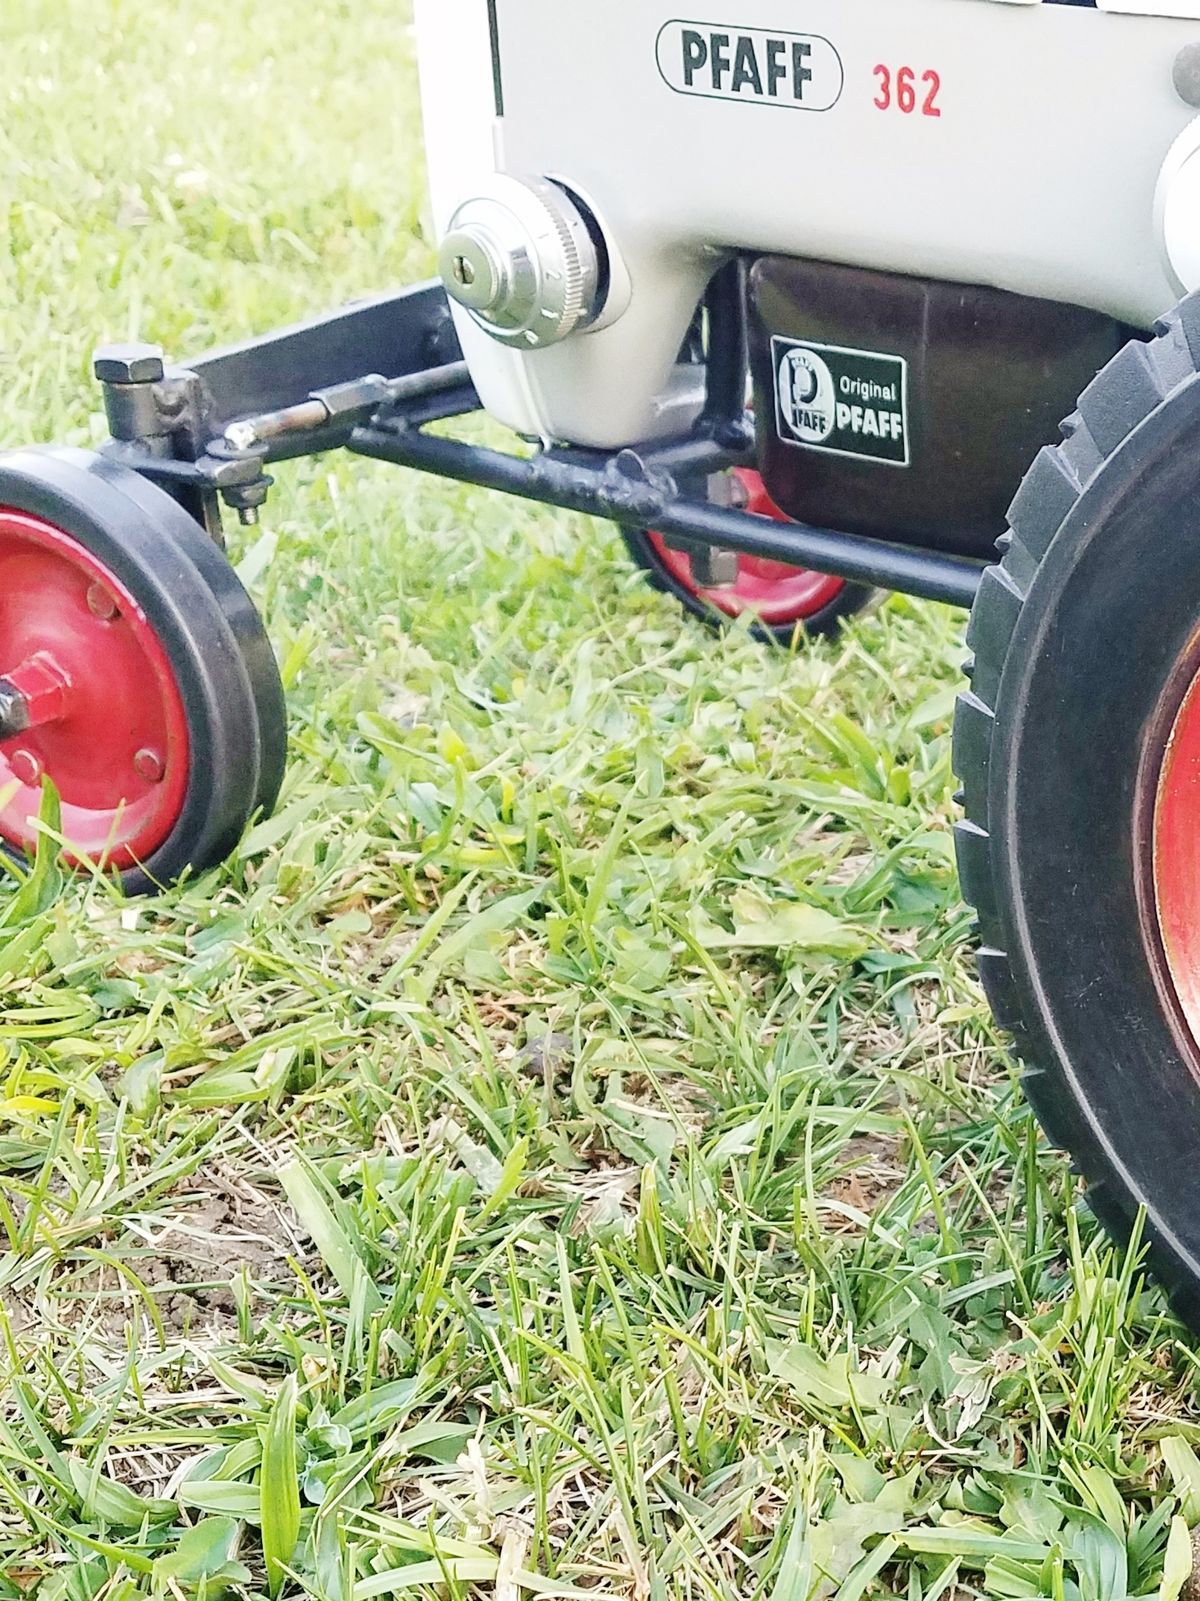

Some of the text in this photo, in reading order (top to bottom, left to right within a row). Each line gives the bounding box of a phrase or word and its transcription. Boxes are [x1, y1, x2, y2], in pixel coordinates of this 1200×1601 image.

[681, 29, 812, 100] PFAFF
[873, 64, 940, 117] 362
[839, 375, 898, 401] Original
[836, 401, 903, 440] PFAFF
